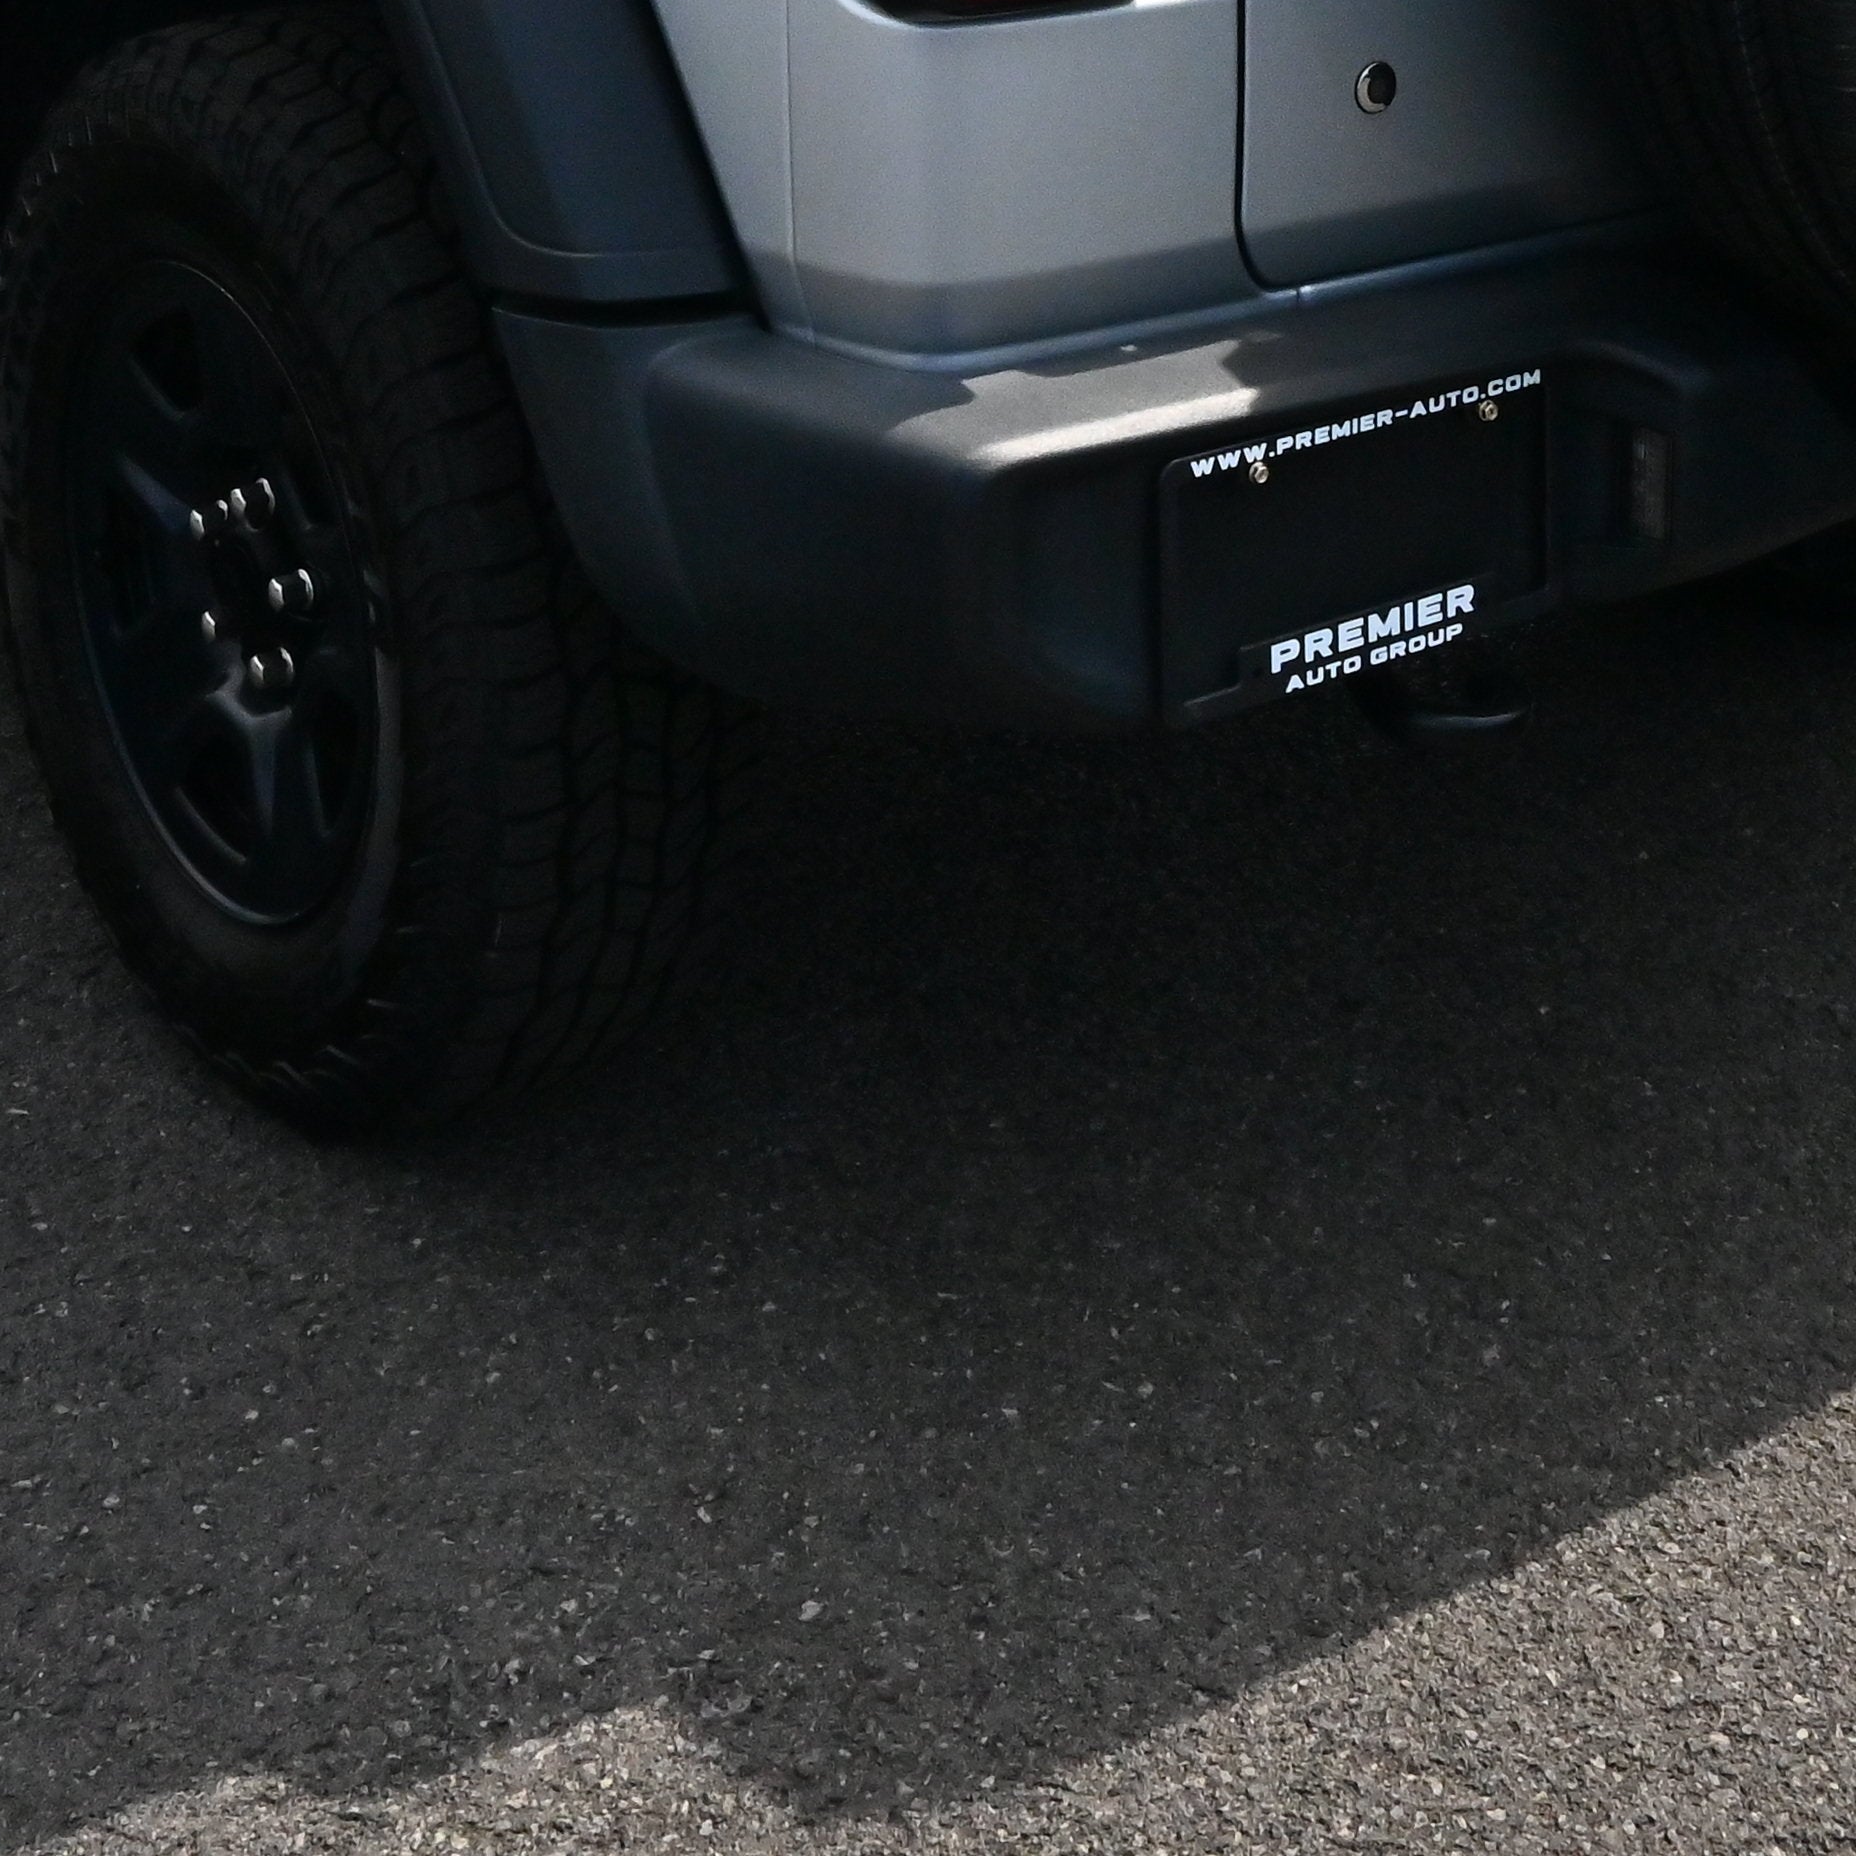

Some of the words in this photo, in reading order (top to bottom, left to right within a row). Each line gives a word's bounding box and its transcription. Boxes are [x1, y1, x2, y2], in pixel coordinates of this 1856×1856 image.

[1191, 369, 1541, 477] WWW.PREMIER-AUTO.COM
[1271, 584, 1475, 673] PREMIER
[1285, 655, 1361, 693] AUTO
[1370, 623, 1463, 665] GROUP
